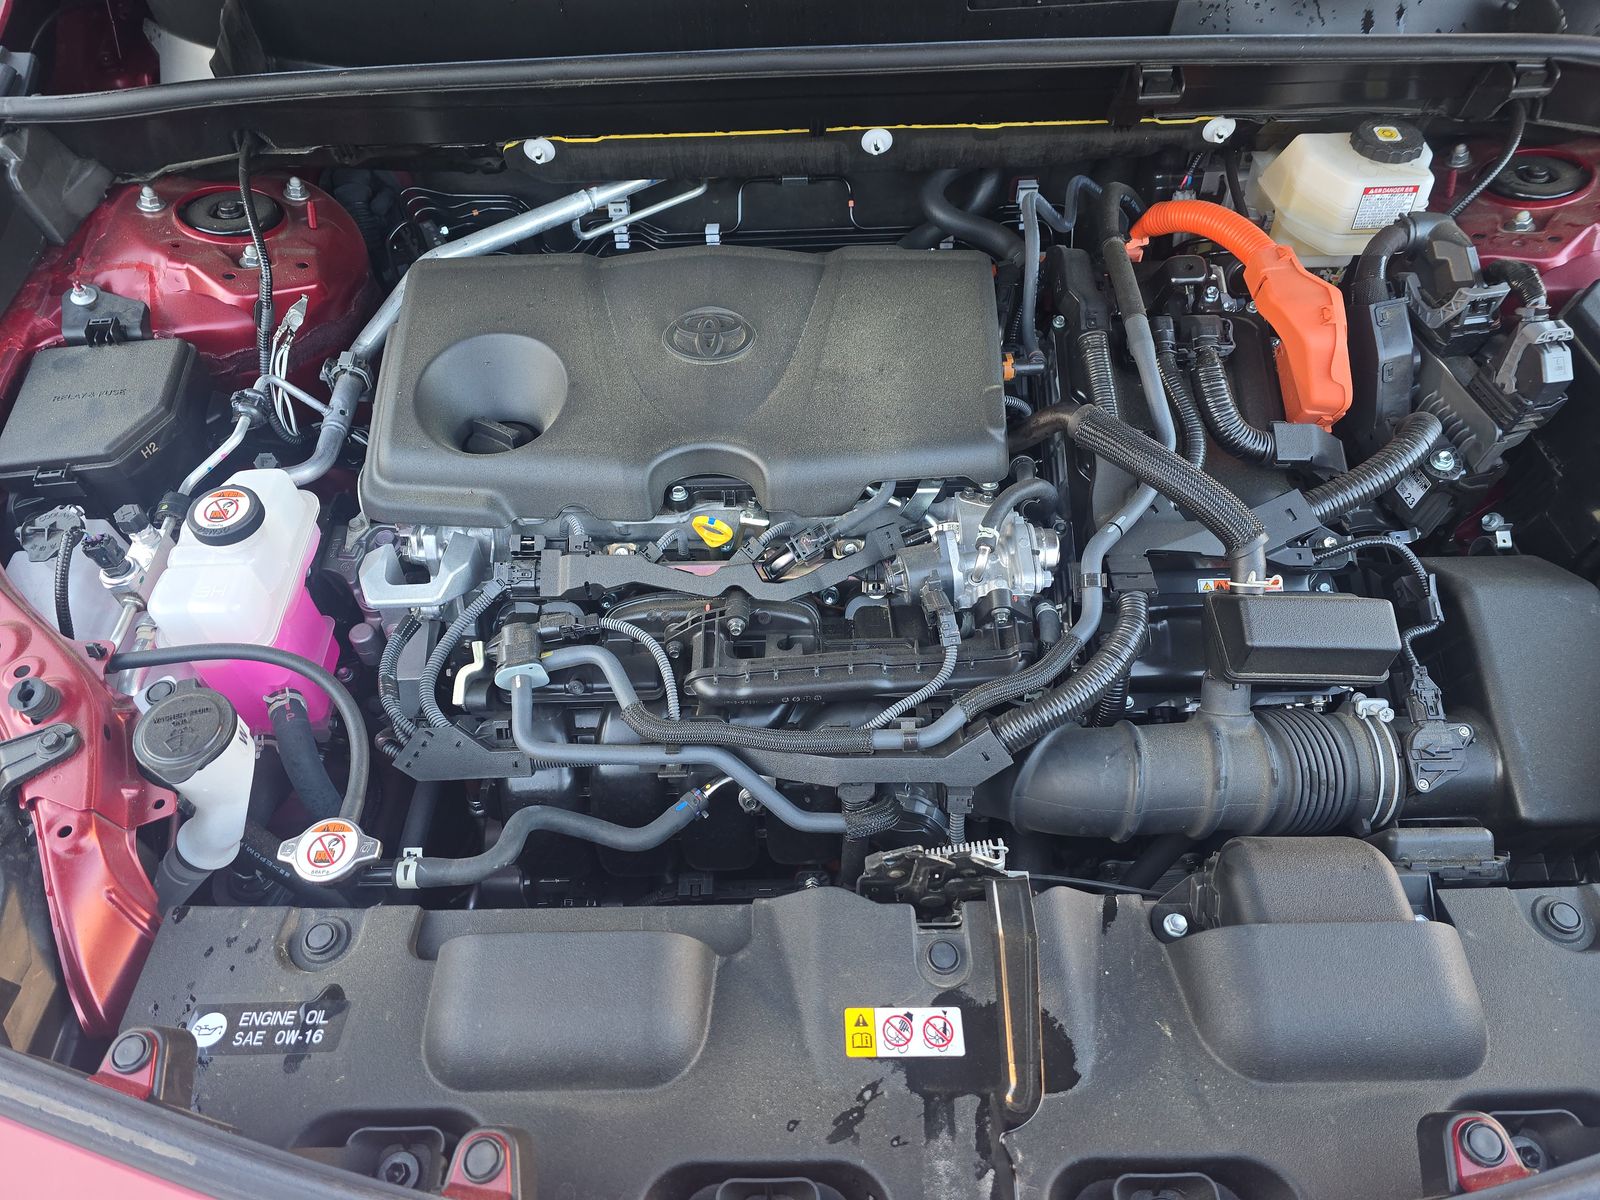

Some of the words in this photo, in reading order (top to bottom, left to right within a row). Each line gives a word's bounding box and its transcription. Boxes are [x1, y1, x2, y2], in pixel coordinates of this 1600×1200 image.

[141, 442, 159, 459] H2
[1405, 493, 1415, 505] 23
[239, 1010, 297, 1026] ENGINE
[305, 1009, 329, 1026] OIL
[232, 1030, 267, 1046] SAE
[274, 1029, 324, 1045] 0W-16
